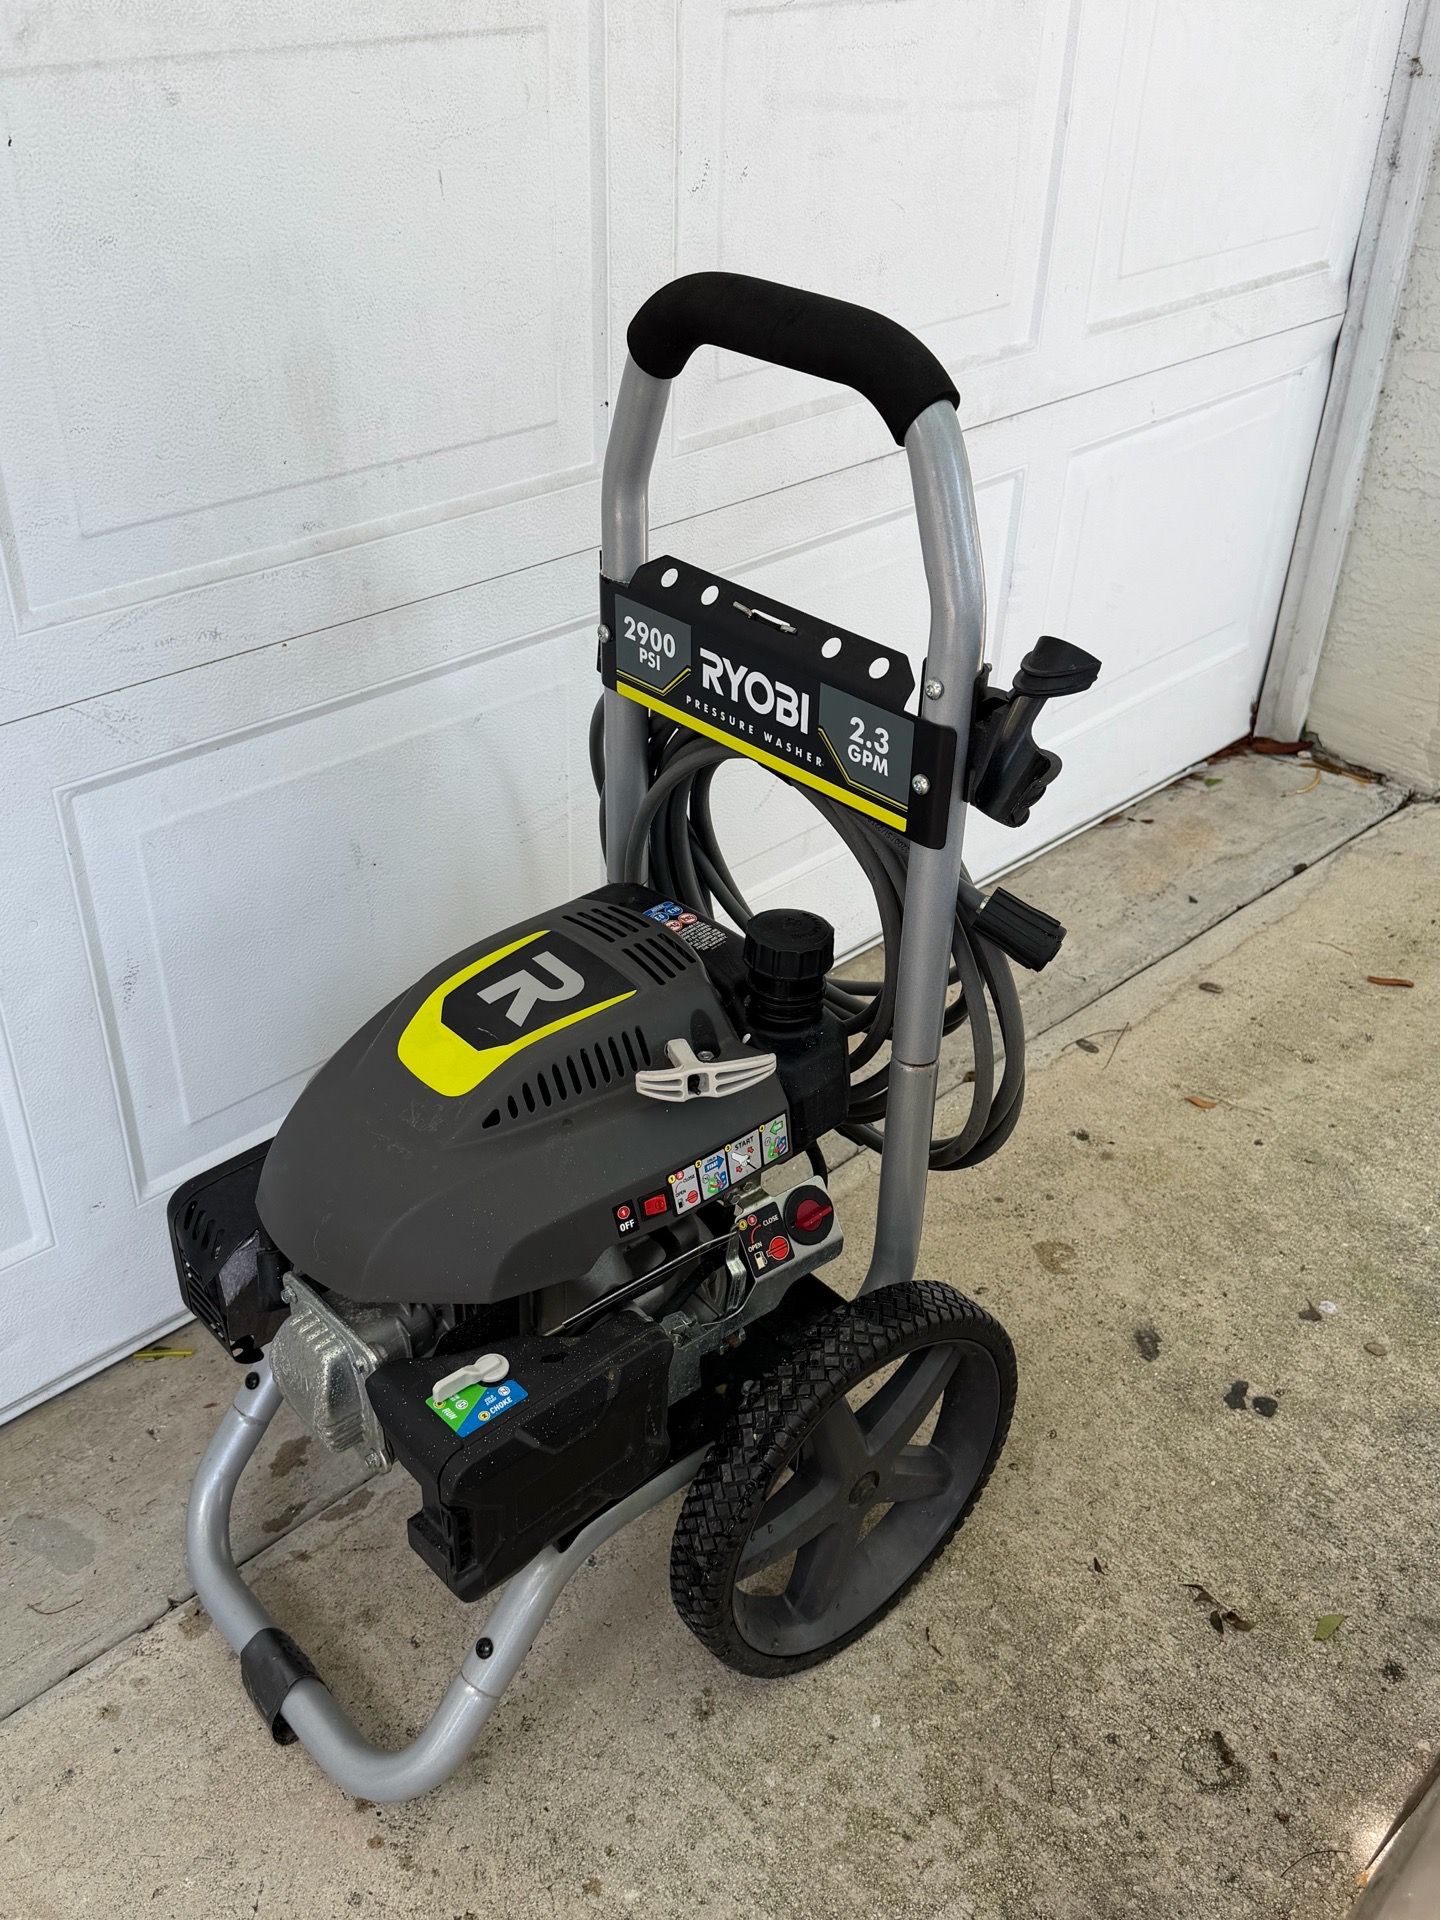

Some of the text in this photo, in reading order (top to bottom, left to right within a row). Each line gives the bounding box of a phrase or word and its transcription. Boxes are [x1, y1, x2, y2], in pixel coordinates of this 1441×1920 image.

[623, 616, 676, 658] 2900
[638, 651, 661, 671] PSI
[700, 647, 810, 735] RYOBI
[686, 694, 822, 767] PRESSURE WASHER
[849, 716, 890, 755] 2.3
[848, 744, 889, 776] GPM
[476, 951, 585, 1027] R
[735, 1135, 754, 1151] START
[619, 1219, 635, 1232] OFF
[763, 1214, 779, 1226] CLOSE
[747, 1241, 763, 1253] OPEN
[490, 1396, 513, 1414] CHOKE
